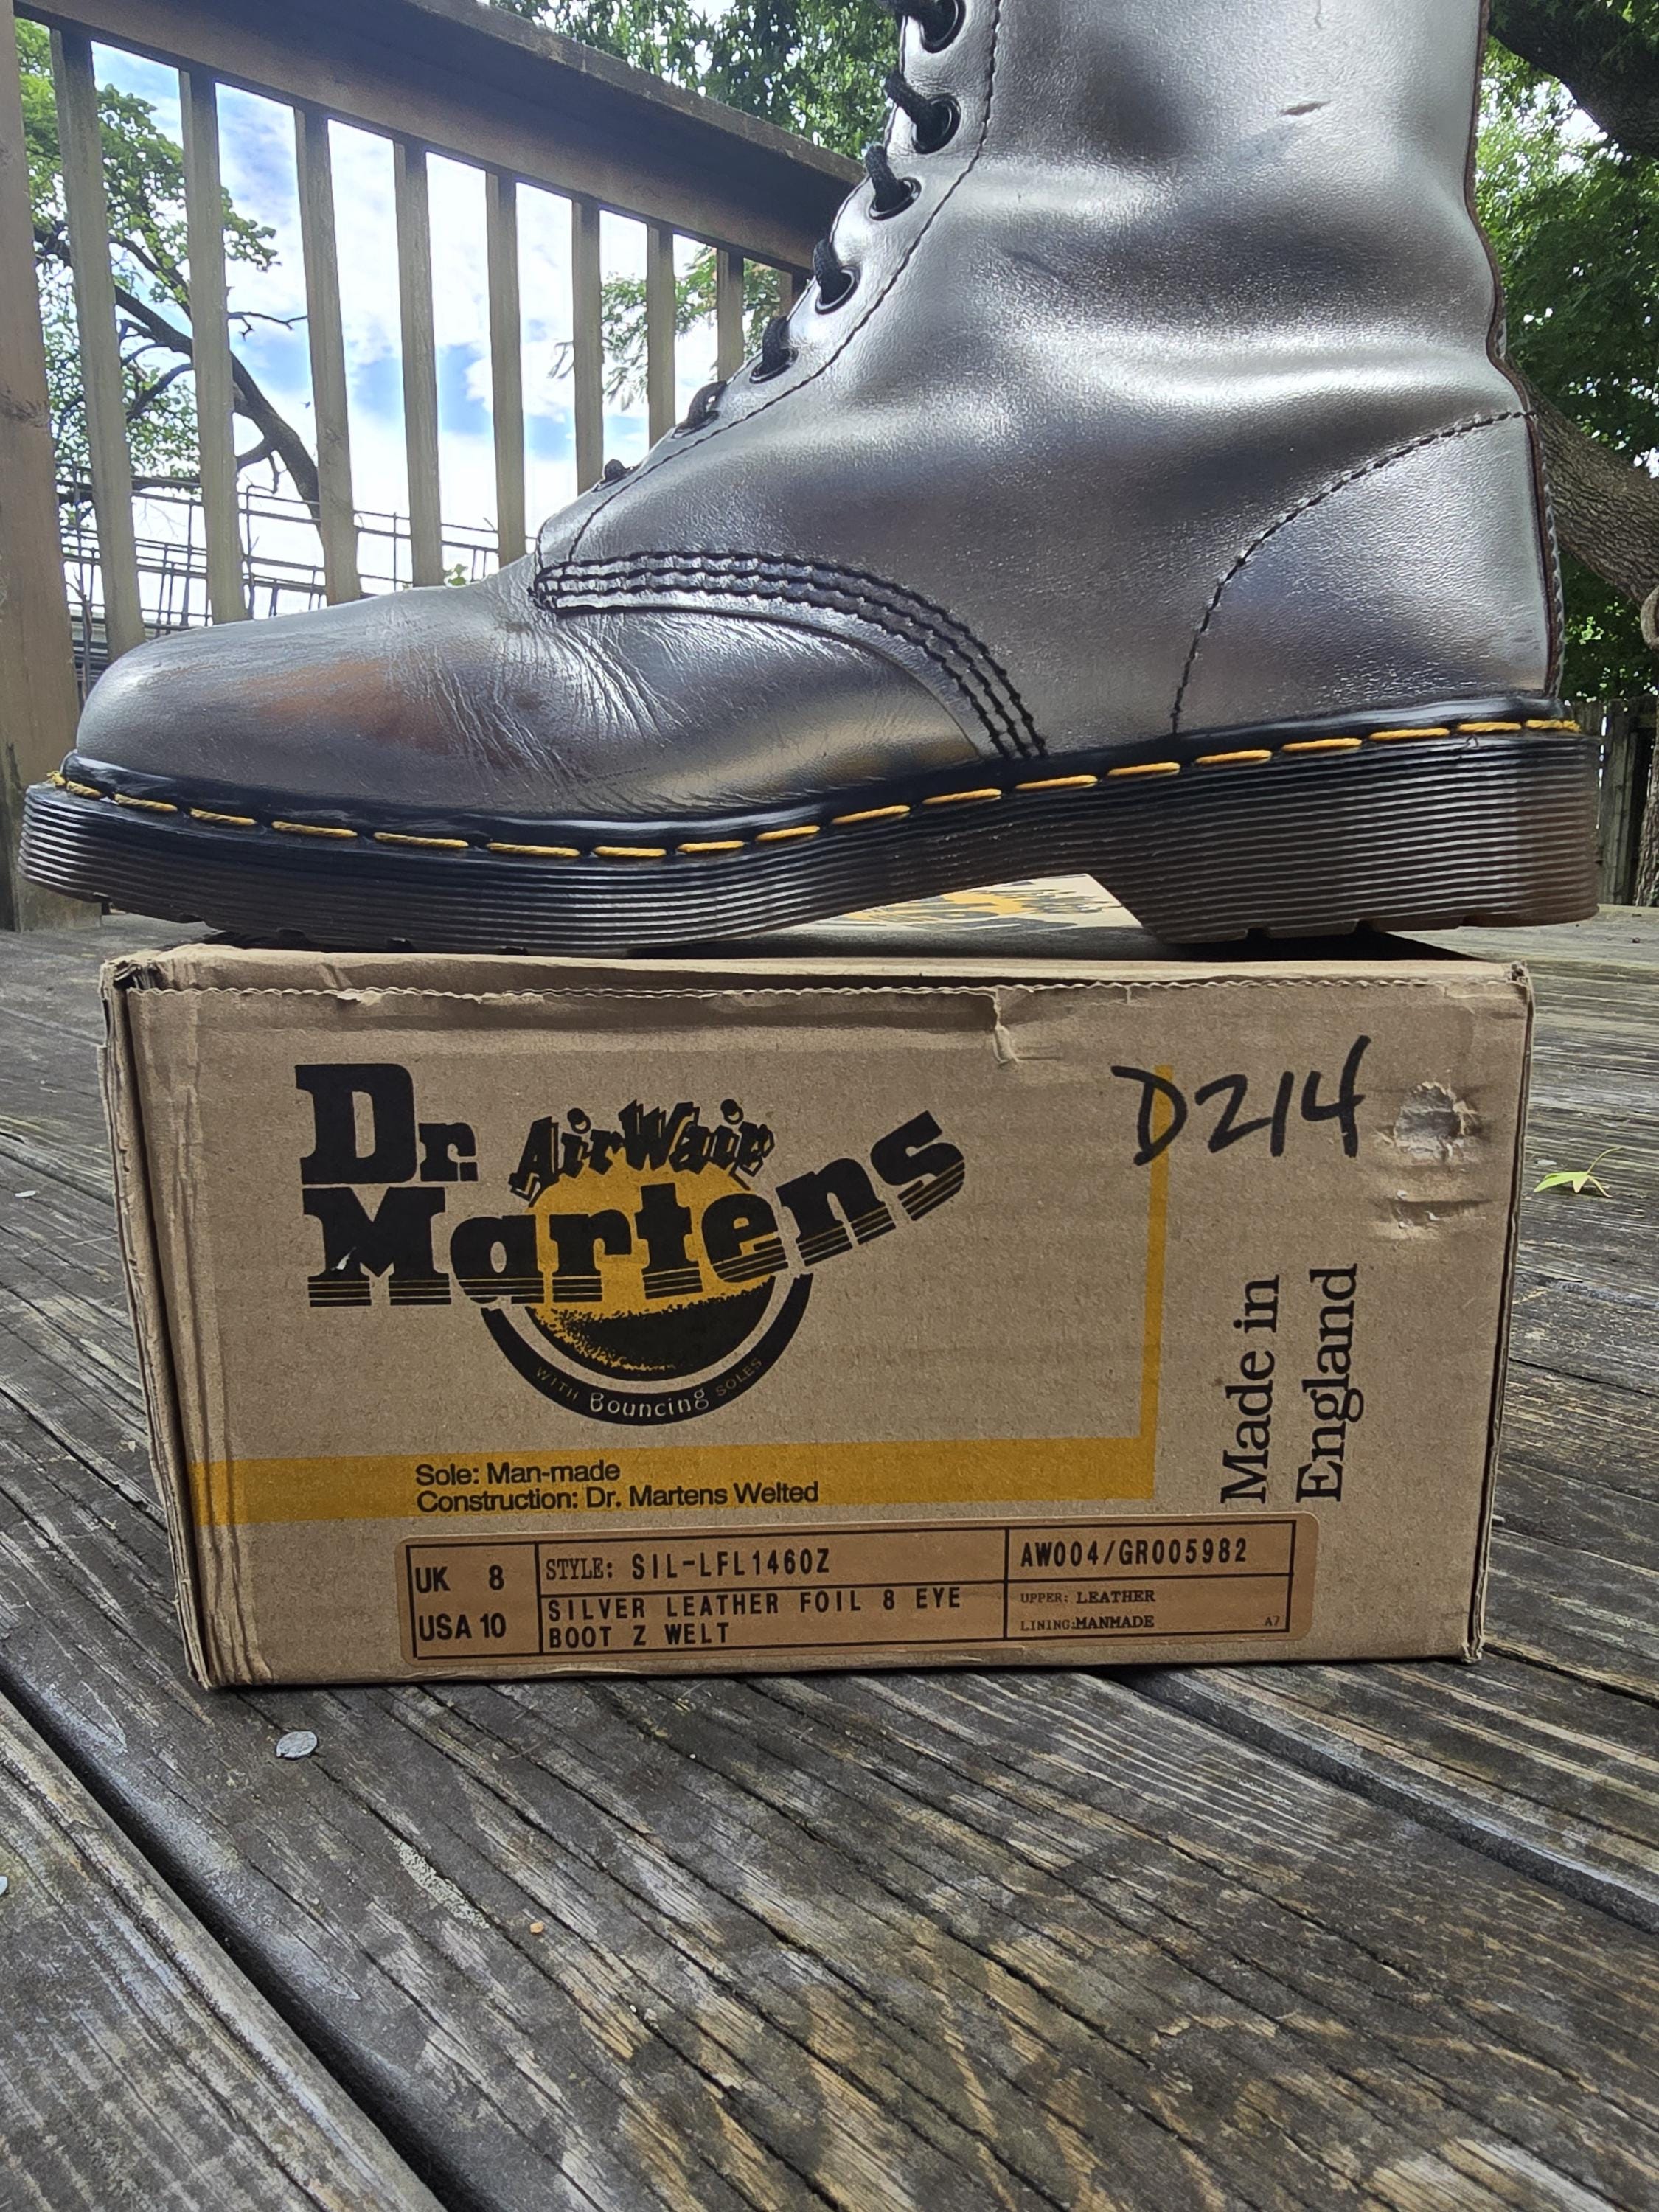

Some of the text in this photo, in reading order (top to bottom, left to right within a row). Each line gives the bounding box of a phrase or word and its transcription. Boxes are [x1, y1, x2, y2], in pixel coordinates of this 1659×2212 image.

[1110, 1035, 1371, 1166] D214
[295, 1064, 479, 1181] Dr.
[509, 1099, 774, 1200] AirWair
[302, 1111, 965, 1307] Martens
[537, 1357, 762, 1417] WITH Bouncing SOLES
[1220, 1274, 1279, 1503] Made in
[1296, 1263, 1364, 1502] England
[416, 1460, 621, 1486] Sole: Man-made
[417, 1481, 819, 1513] Construction: Dr. Martens Welted
[546, 1548, 830, 1581] STYLE: SIL-LFL1460Z
[1020, 1537, 1248, 1568] AW004/GR005982
[415, 1565, 504, 1593] UK 8
[548, 1587, 961, 1621] SILVER LEATHER FOIL 8 EYE
[1020, 1590, 1155, 1605] UPPER: LEATHER
[419, 1613, 507, 1641] USA 10
[549, 1621, 729, 1649] BOOT Z WELT
[1076, 1615, 1155, 1630] MANMADE
